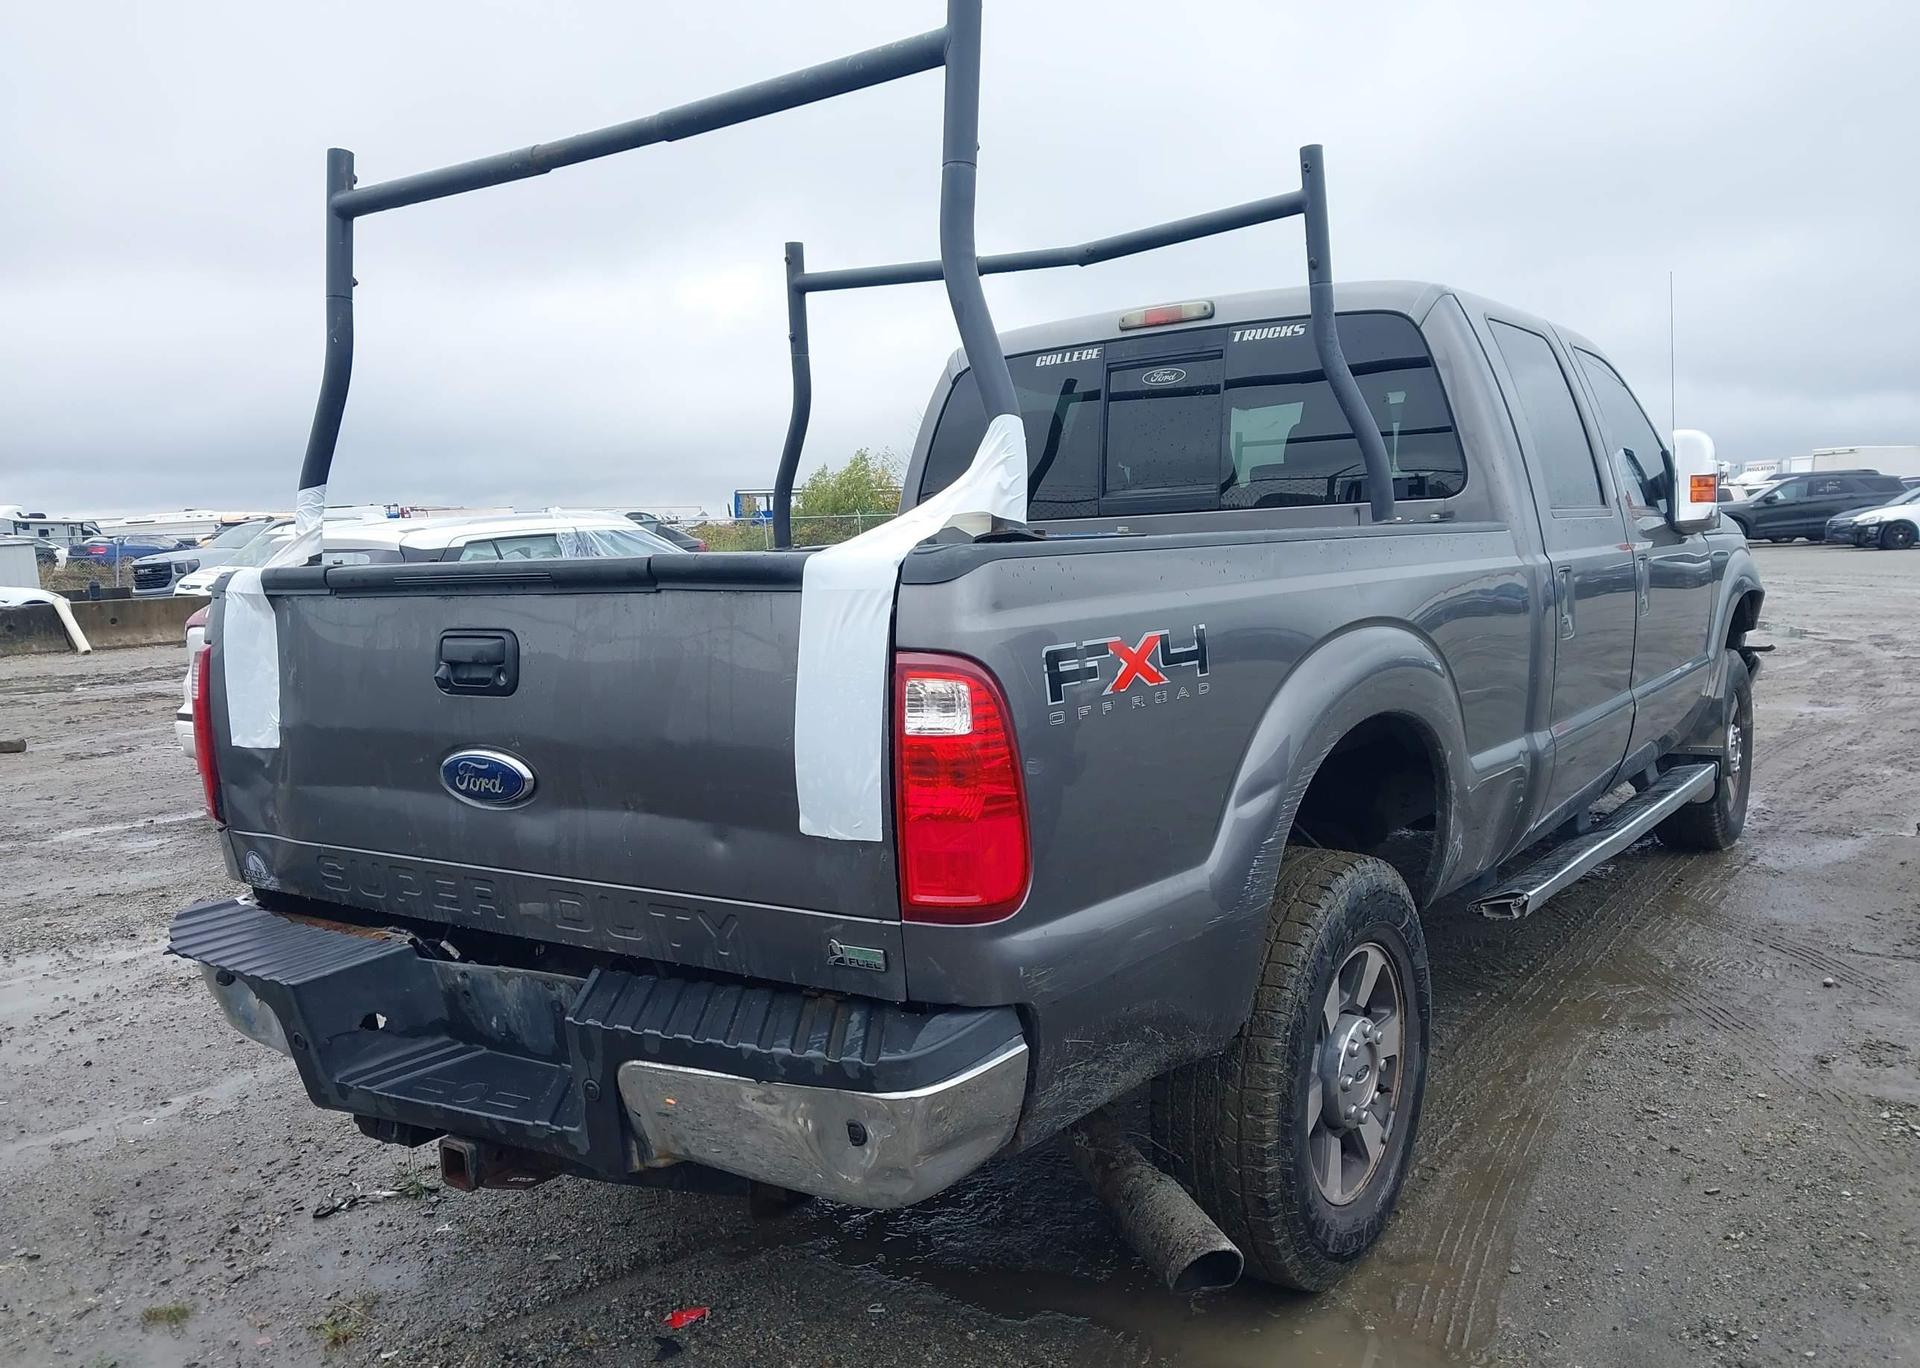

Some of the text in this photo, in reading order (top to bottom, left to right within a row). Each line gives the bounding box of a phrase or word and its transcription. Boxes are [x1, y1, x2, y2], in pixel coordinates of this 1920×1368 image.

[1035, 324, 1306, 367] COLLEGE TRUCKS
[1150, 370, 1179, 383] Ford
[1042, 624, 1210, 706] FX4
[1049, 682, 1211, 726] OFF ROAD
[455, 760, 504, 794] Ford
[316, 854, 739, 956] SUPER DUTY
